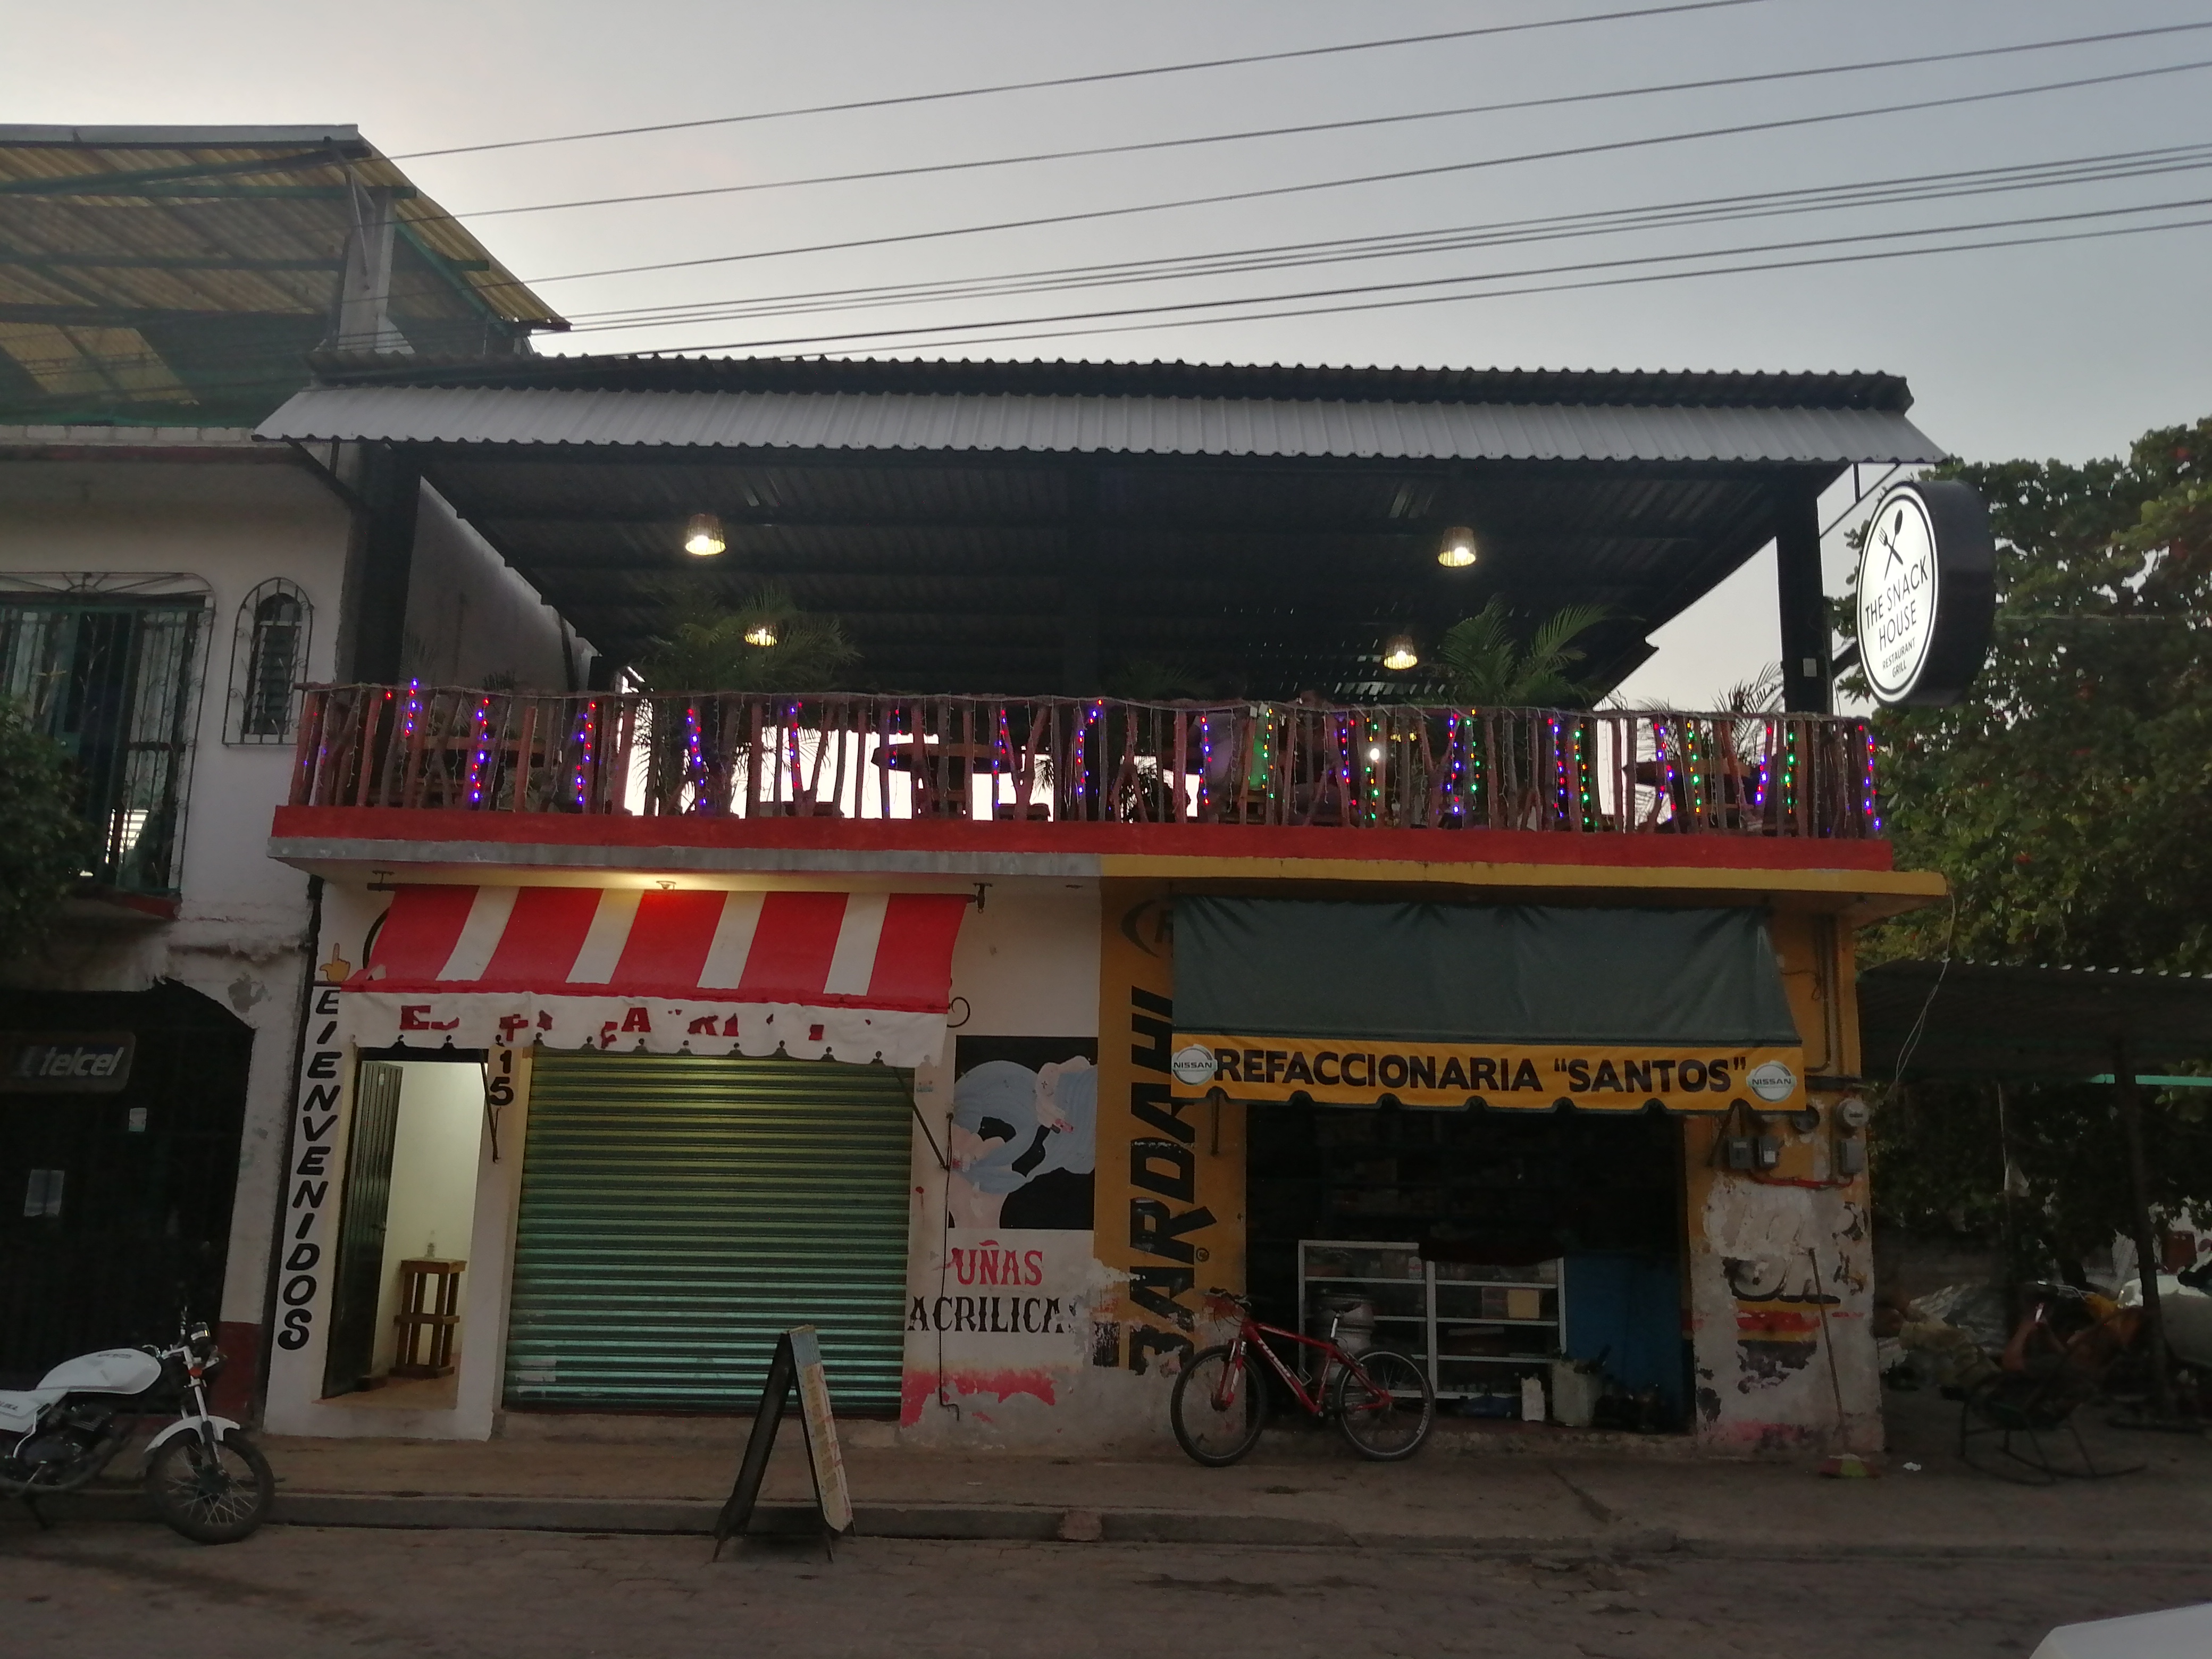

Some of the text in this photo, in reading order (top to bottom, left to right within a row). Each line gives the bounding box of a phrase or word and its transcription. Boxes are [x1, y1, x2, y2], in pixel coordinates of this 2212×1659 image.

[1865, 555, 1928, 630] THE SNACK
[1879, 599, 1916, 651] HOUSE
[1882, 637, 1915, 671] RESTAURANT
[1892, 659, 1907, 678] GRILL
[39, 1046, 124, 1076] telcel
[1214, 1048, 1543, 1092] REFACCIONARIA
[1752, 1077, 1792, 1086] NISSAN
[951, 1239, 1043, 1286] UÑAS
[907, 1296, 1078, 1334] ACRILICA
